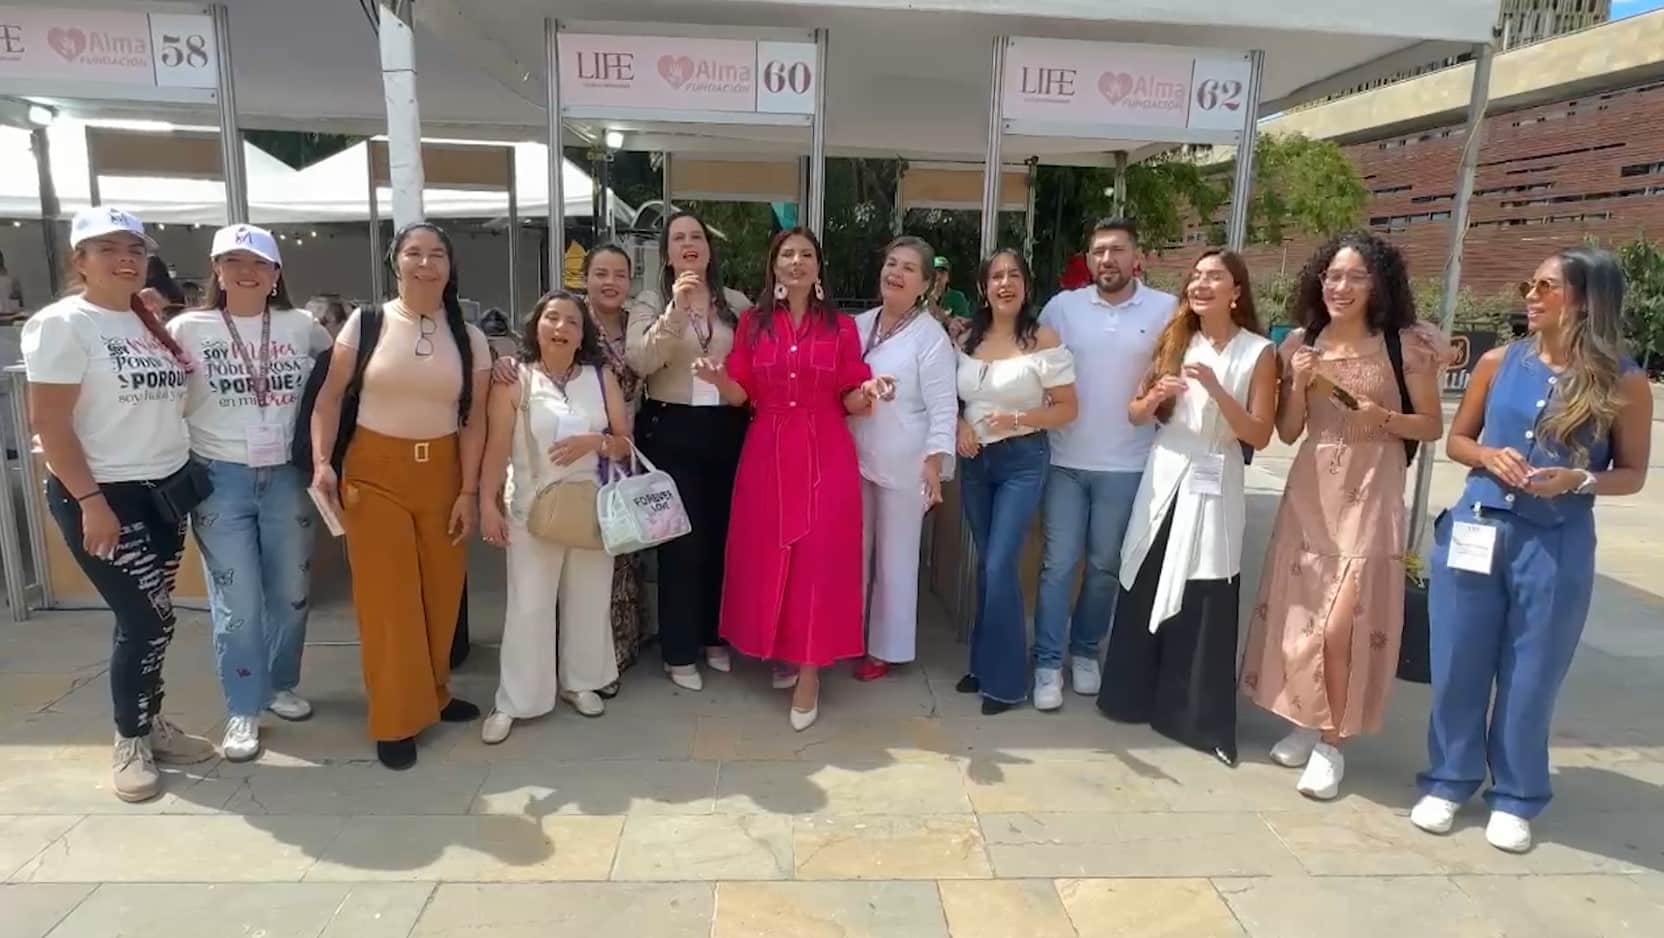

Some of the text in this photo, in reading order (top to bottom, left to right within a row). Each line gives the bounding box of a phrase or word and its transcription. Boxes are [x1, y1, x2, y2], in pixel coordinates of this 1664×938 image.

[89, 32, 146, 54] Alma
[161, 33, 209, 69] 58
[576, 51, 634, 80] LIFE
[695, 60, 750, 81] Alma
[763, 60, 812, 95] 60
[1021, 66, 1077, 96] LIFE
[1134, 74, 1185, 98] Alma
[1196, 78, 1242, 112] 62
[203, 341, 297, 360] SOY Mjer
[130, 371, 188, 390] PORQU
[633, 490, 672, 507] FOREVER
[651, 501, 671, 512] LOVE
